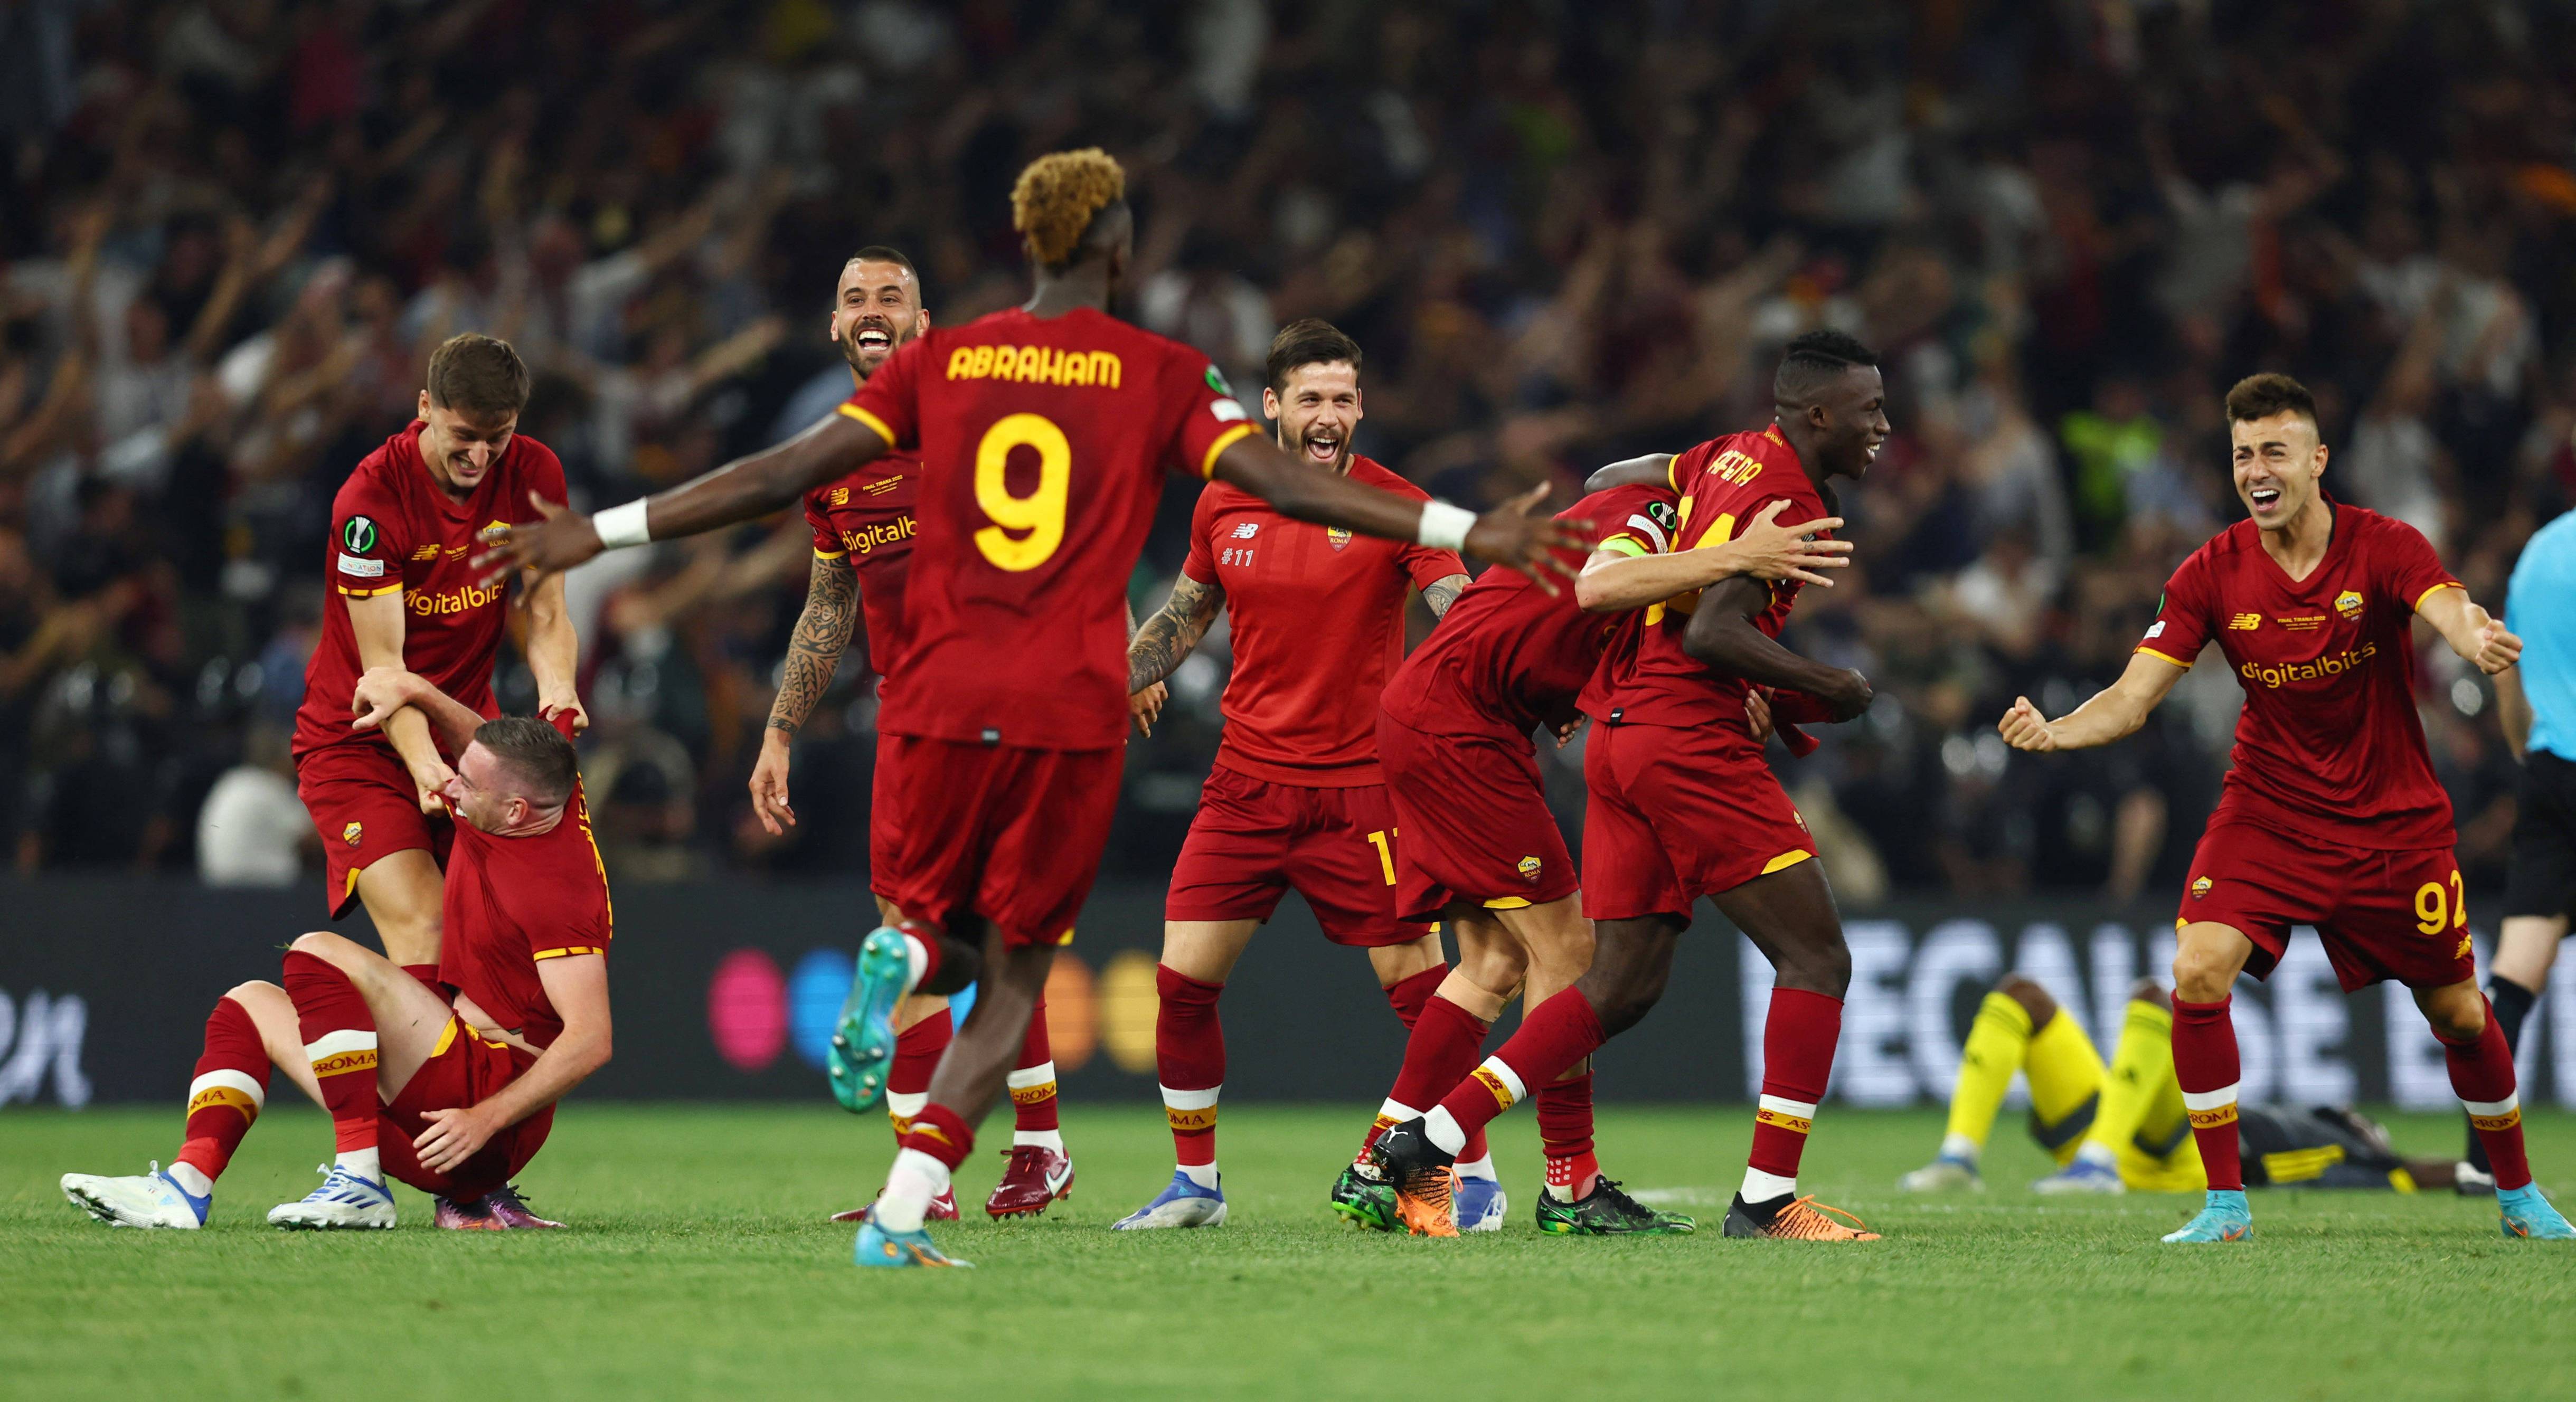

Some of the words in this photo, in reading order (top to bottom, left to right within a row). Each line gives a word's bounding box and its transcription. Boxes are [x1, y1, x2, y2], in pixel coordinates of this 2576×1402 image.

[947, 345, 1122, 389] ABRAHAM
[1706, 449, 1762, 488] AFENA
[974, 413, 1071, 572] 9
[1221, 547, 1254, 566] #11
[2241, 641, 2376, 688] digitalbits
[1367, 827, 1398, 886] 1
[2414, 869, 2467, 935] 92
